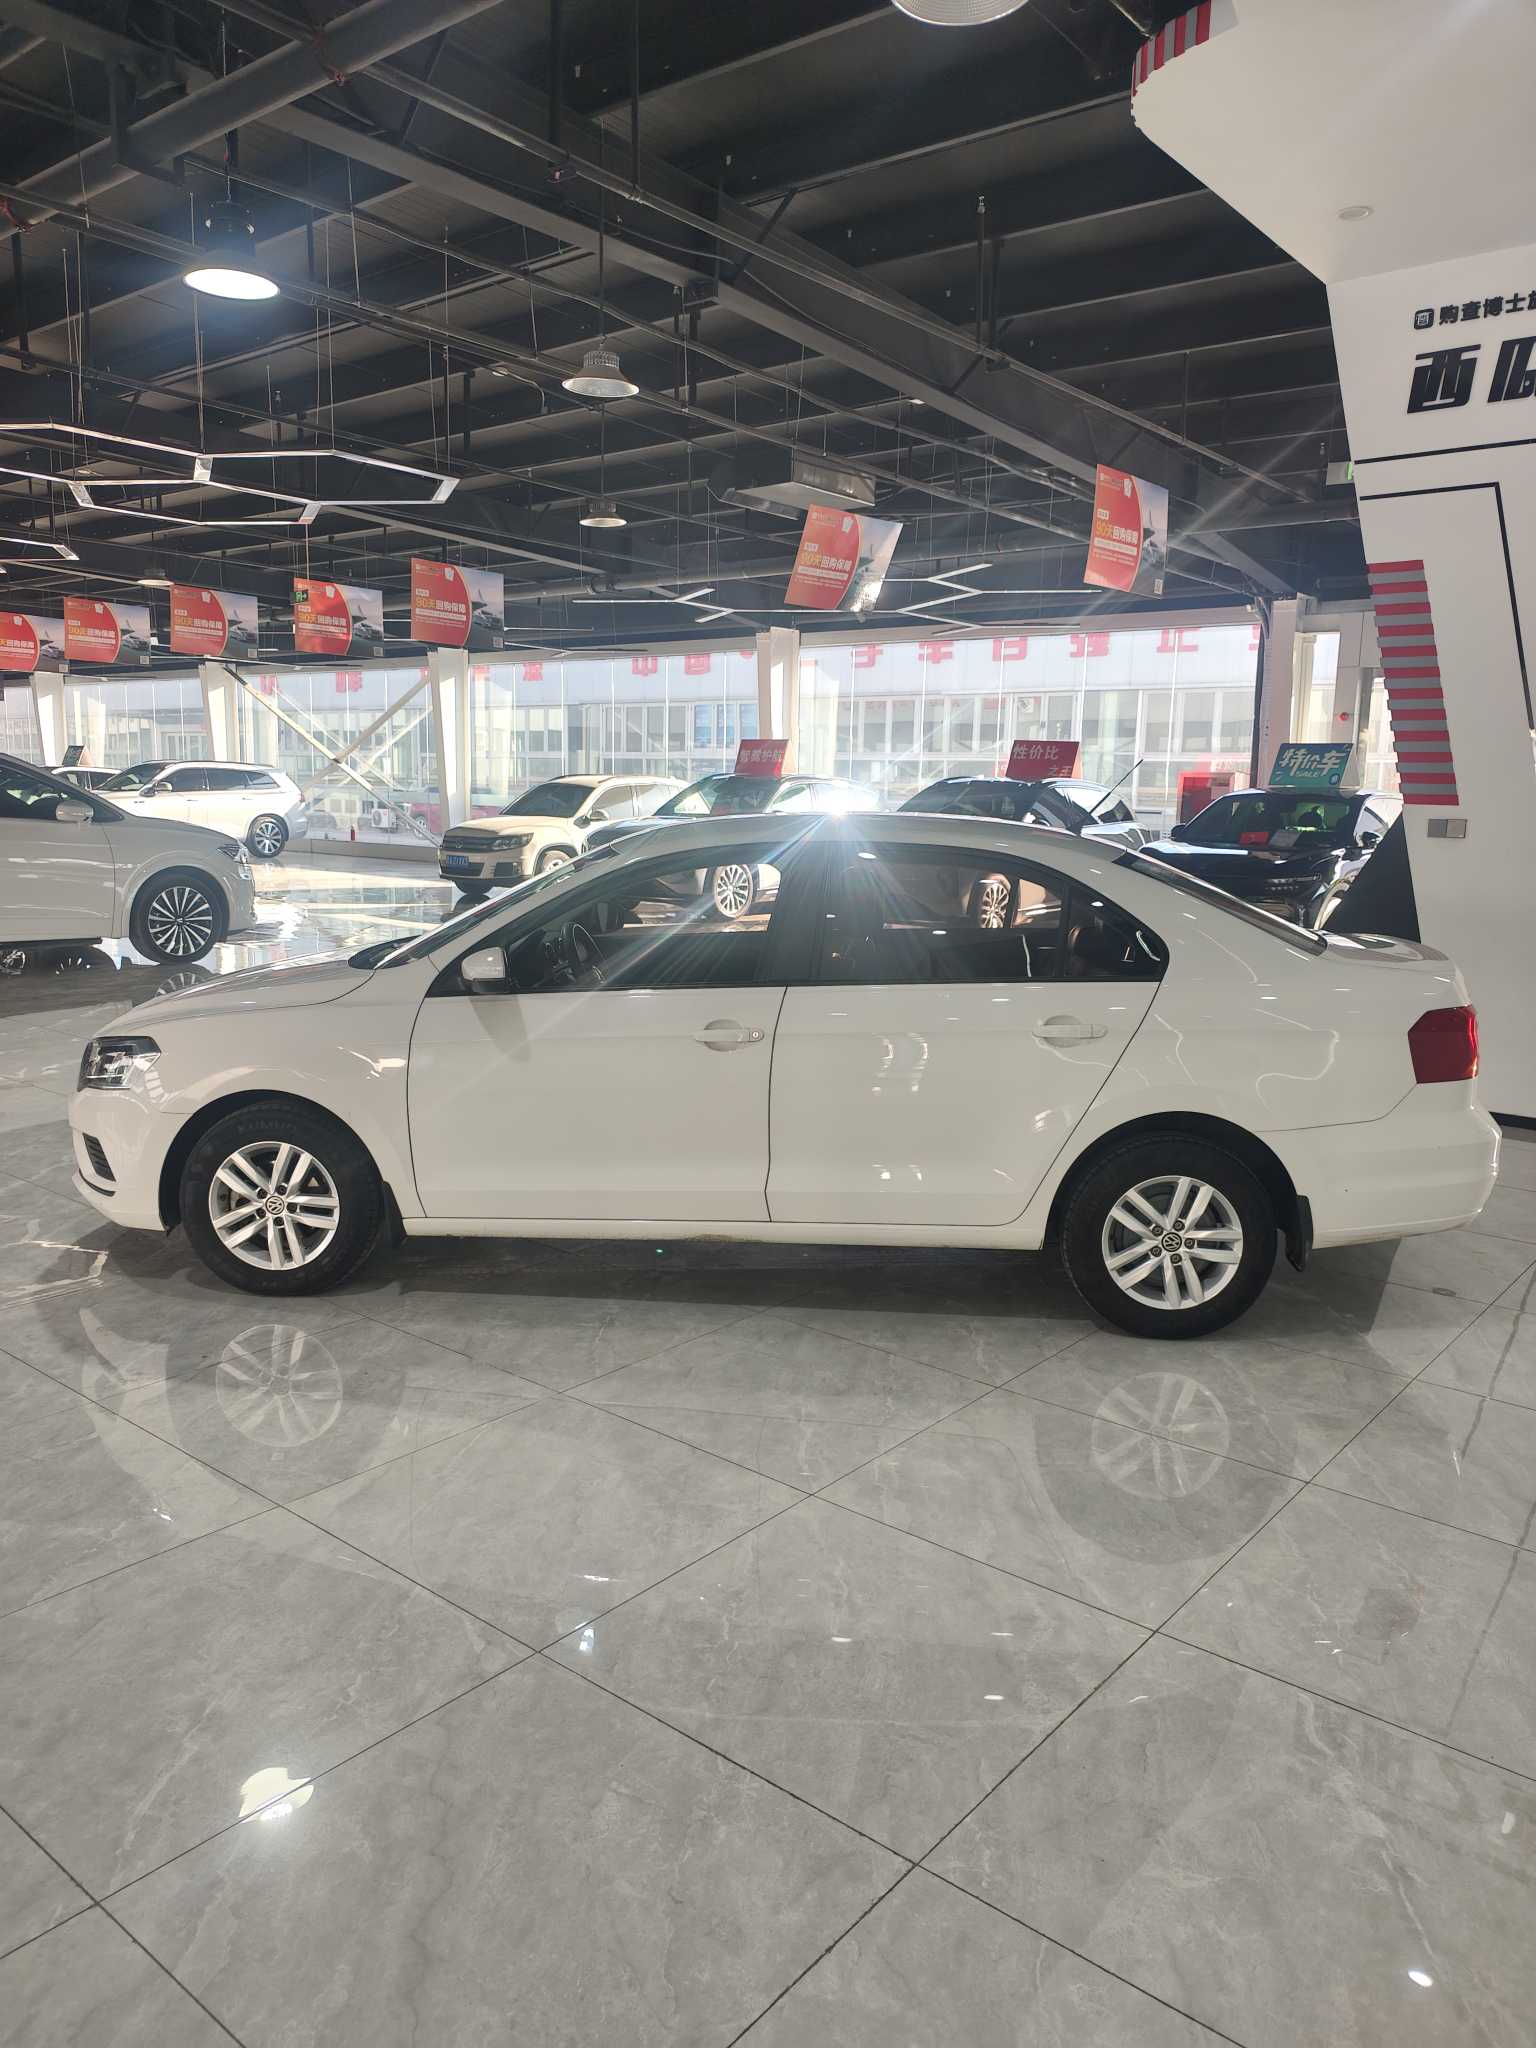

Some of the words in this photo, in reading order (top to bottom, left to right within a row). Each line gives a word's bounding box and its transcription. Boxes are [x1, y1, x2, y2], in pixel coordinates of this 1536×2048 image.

[1013, 744, 1059, 761] 性价比
[1279, 748, 1346, 777] 特价车
